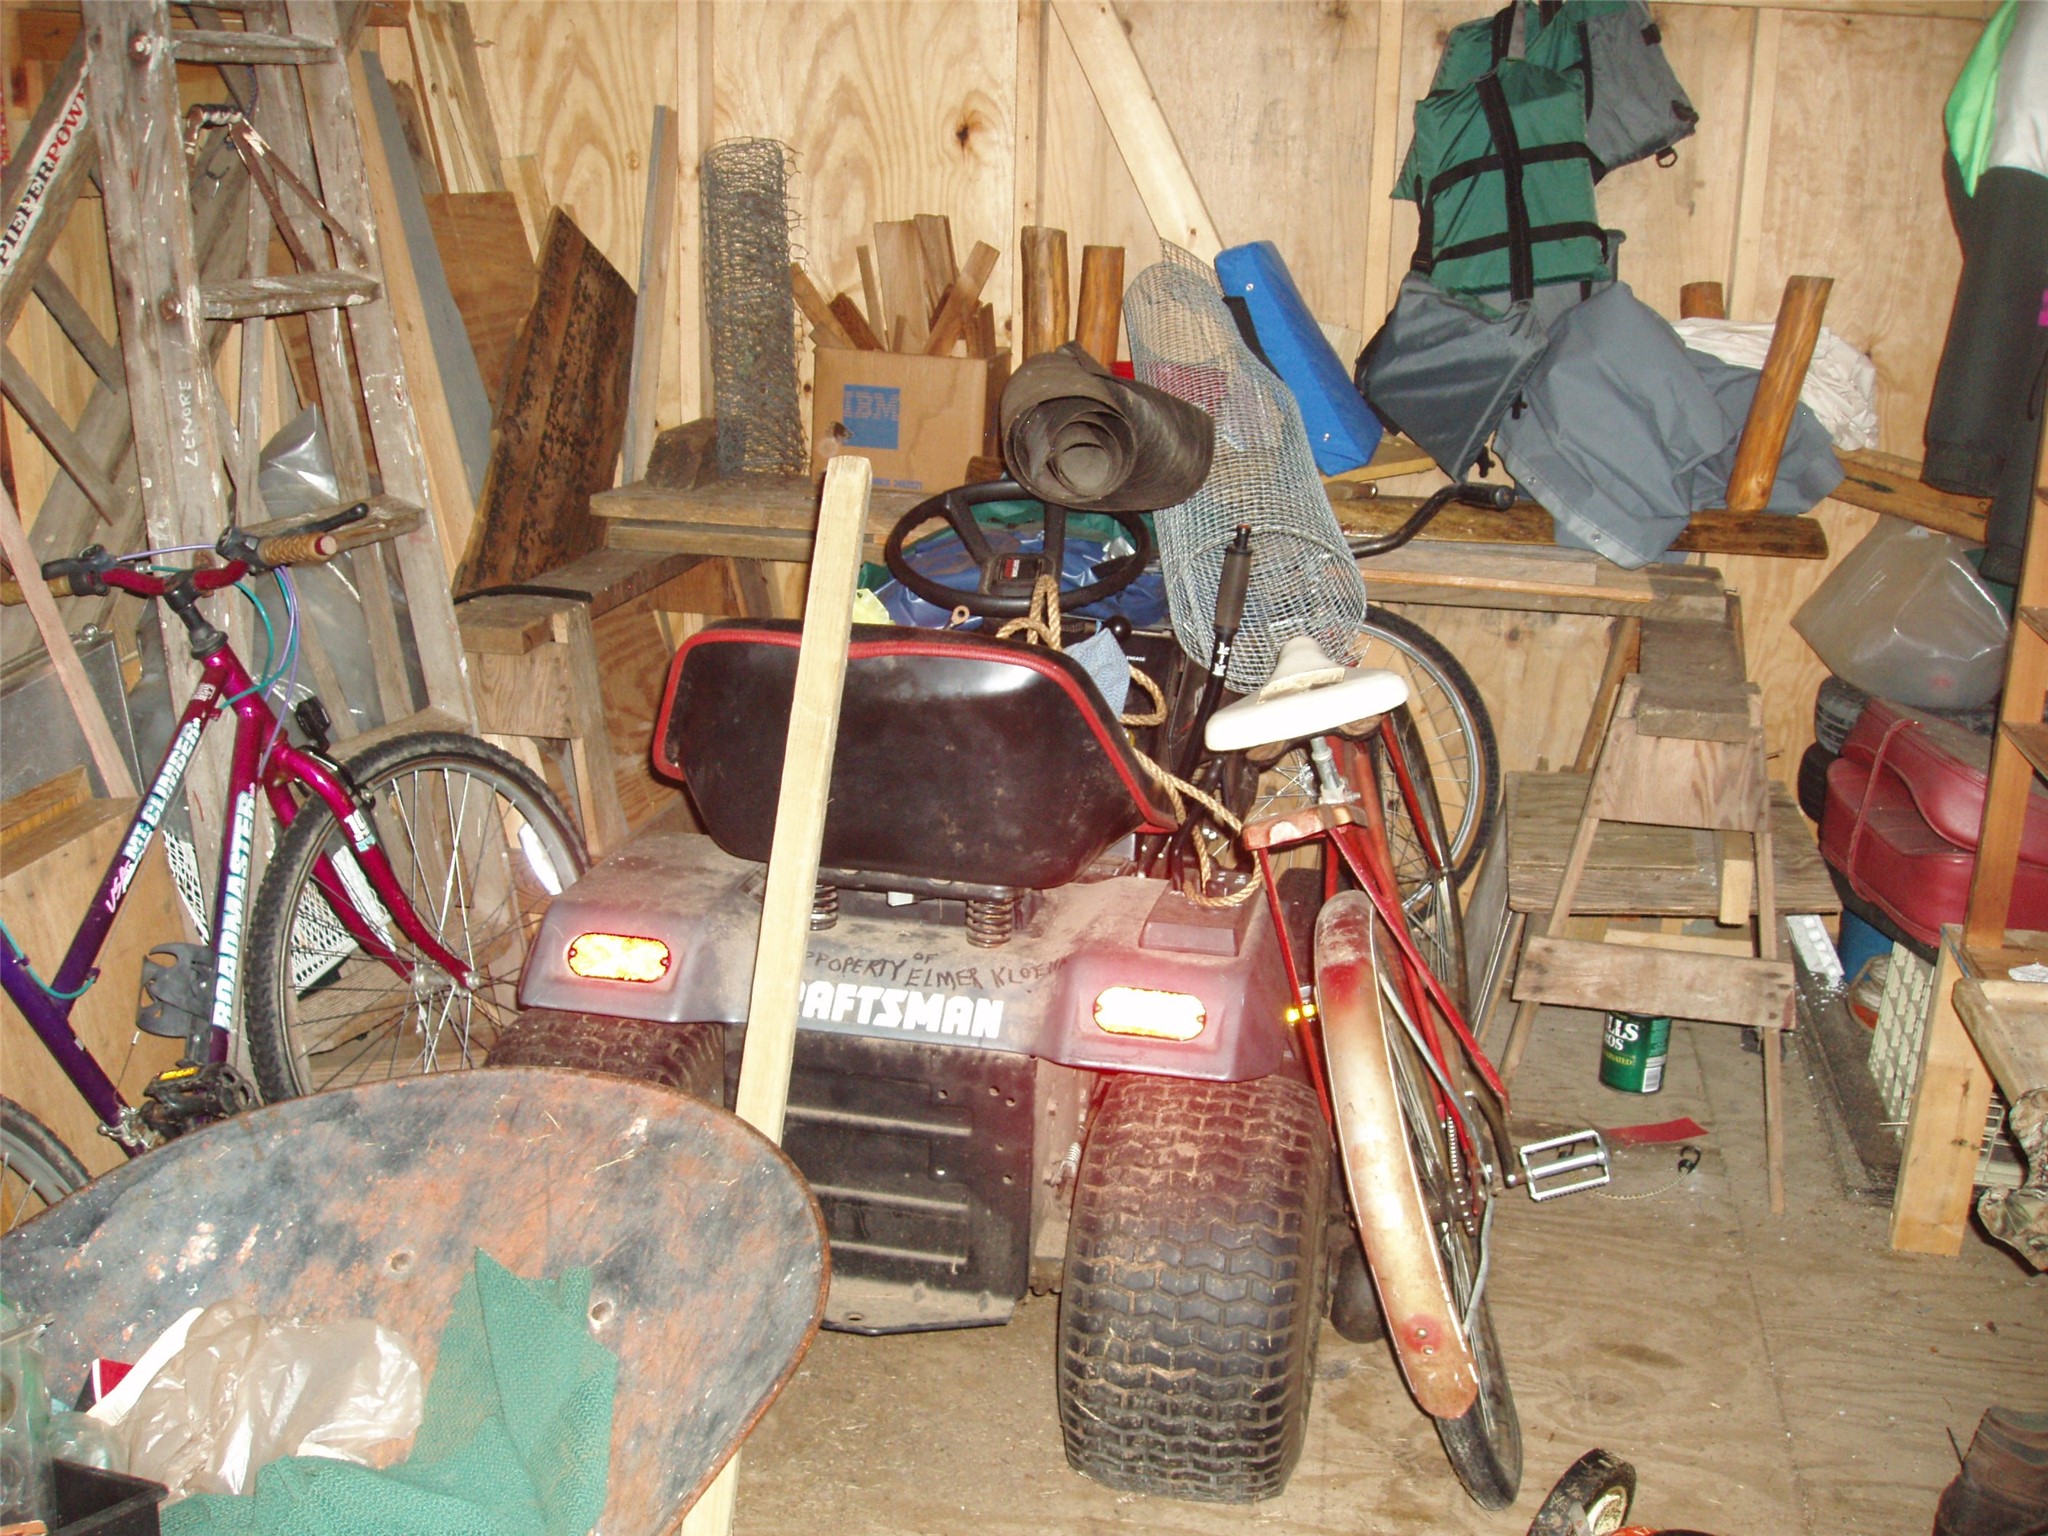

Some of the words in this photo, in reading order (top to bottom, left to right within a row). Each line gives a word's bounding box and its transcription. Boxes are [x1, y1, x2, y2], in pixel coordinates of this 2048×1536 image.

[843, 391, 899, 420] IBM
[141, 721, 199, 827] CLIMBER
[212, 791, 255, 1031] ROADMASTER
[911, 952, 938, 964] OF
[904, 967, 984, 989] ELMER
